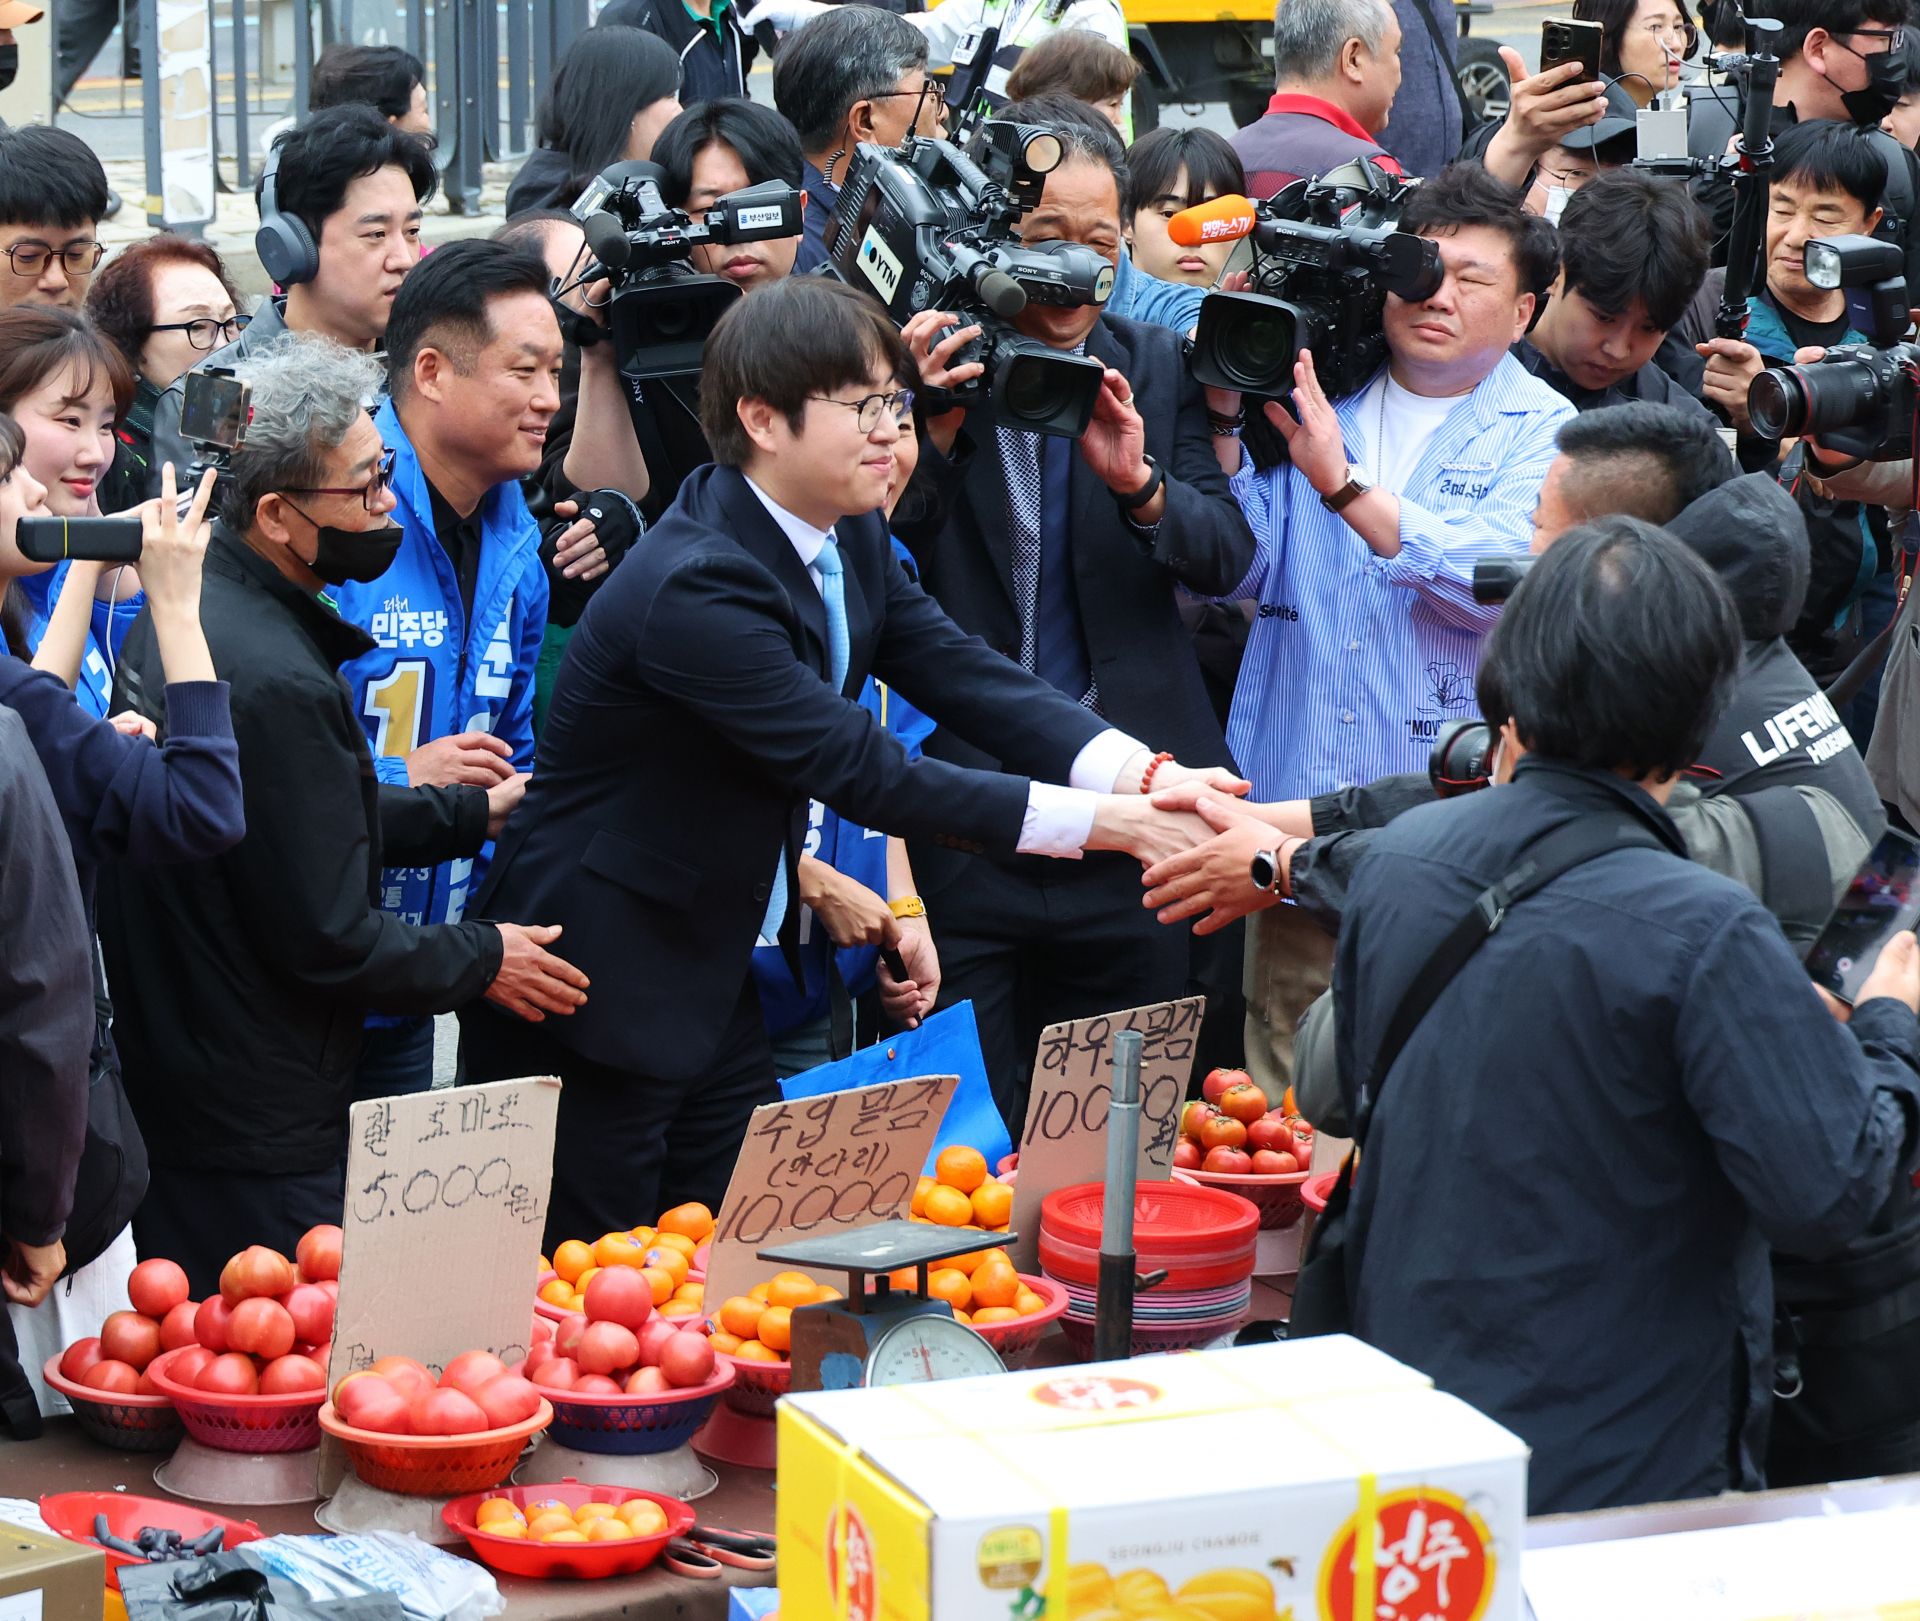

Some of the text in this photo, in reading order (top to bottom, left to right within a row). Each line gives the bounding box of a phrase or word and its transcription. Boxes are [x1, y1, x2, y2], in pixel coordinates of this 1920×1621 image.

[749, 212, 780, 222] 부산일보
[1201, 217, 1251, 239] 연합뉴스TV
[1276, 227, 1299, 236] SONY
[876, 253, 897, 289] YTN
[919, 268, 937, 285] SONY
[1017, 266, 1038, 275] SONY
[631, 379, 644, 404] ONY
[371, 610, 448, 648] 민주당
[364, 661, 426, 758] 1
[417, 1091, 534, 1143] 토마토
[753, 1094, 838, 1154] 수입
